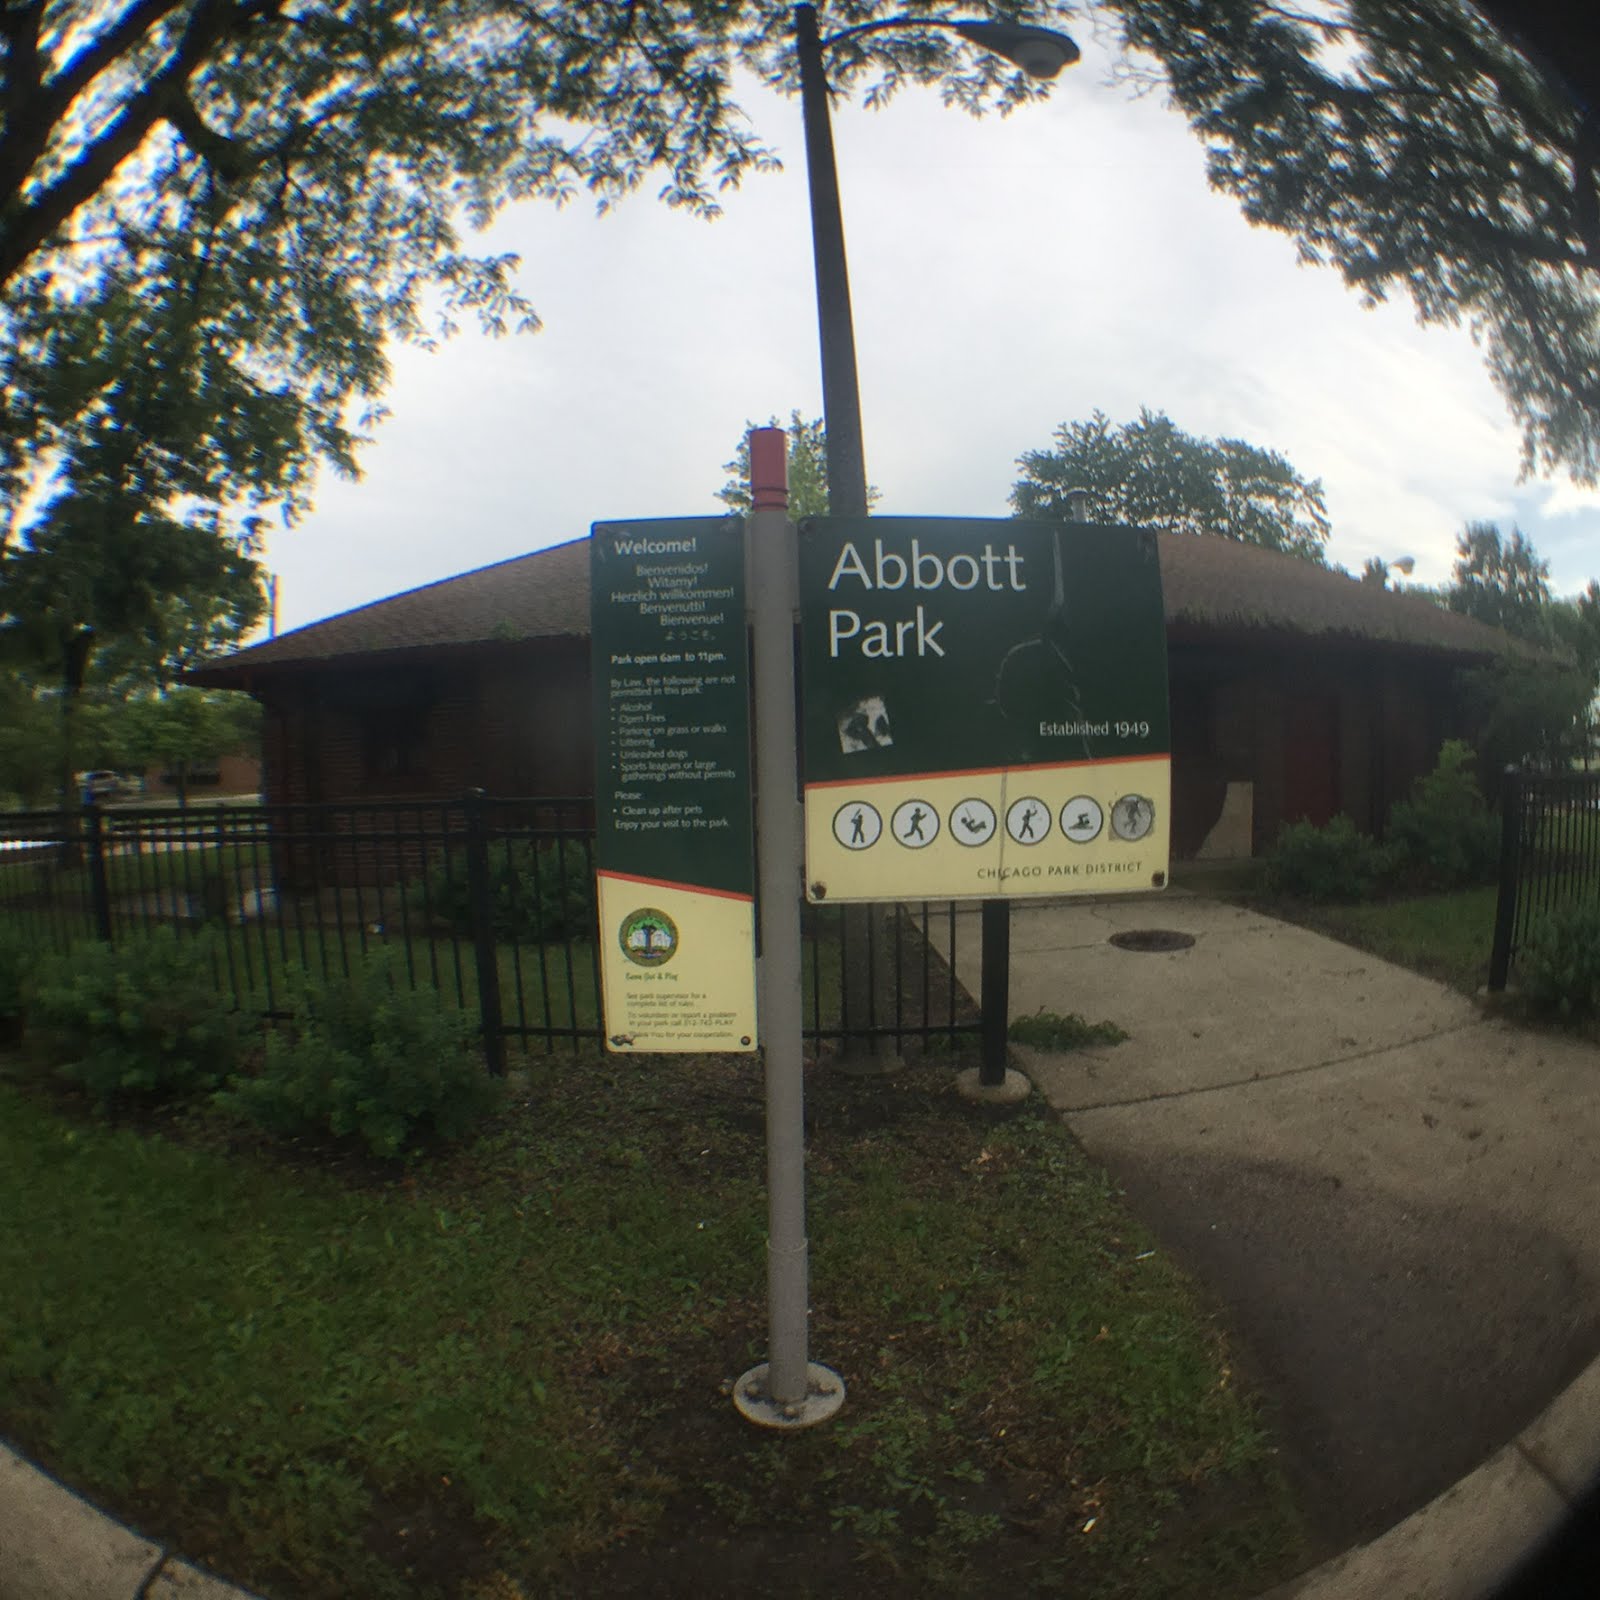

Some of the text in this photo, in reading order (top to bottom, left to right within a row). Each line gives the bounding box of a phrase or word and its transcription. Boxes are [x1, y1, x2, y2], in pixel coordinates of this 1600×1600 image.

[614, 537, 697, 555] Welcome!
[636, 562, 708, 577] Bienvenidos!
[828, 538, 1027, 592] Abbott
[648, 576, 698, 589] Witamy!
[611, 587, 735, 603] Herzlich willkommen!
[660, 612, 724, 626] Bienvenue!
[829, 605, 946, 658] Park
[611, 654, 632, 664] Park
[633, 656, 658, 666] open
[660, 652, 681, 662] 6am
[685, 652, 696, 662] to
[646, 677, 660, 687] the
[662, 675, 703, 687] following
[720, 674, 736, 685] not
[664, 686, 679, 696] this
[620, 702, 653, 713] Alcohol
[620, 715, 644, 725] Open
[653, 727, 665, 735] on
[667, 726, 689, 737] grass
[690, 726, 701, 734] or
[702, 723, 728, 735] walks
[1039, 721, 1150, 739] Established 1949
[620, 749, 688, 760] Unleashed dogs
[682, 762, 693, 770] or
[694, 760, 717, 771] large
[667, 770, 702, 780] without
[703, 769, 736, 780] permits
[622, 804, 703, 817] Clean up after pets
[615, 819, 639, 830] Enjoy
[640, 820, 661, 830] your
[662, 818, 680, 828] visit
[681, 818, 691, 828] to
[693, 817, 707, 828] the
[977, 861, 1143, 881] CHICAGO PARK DISTRICT
